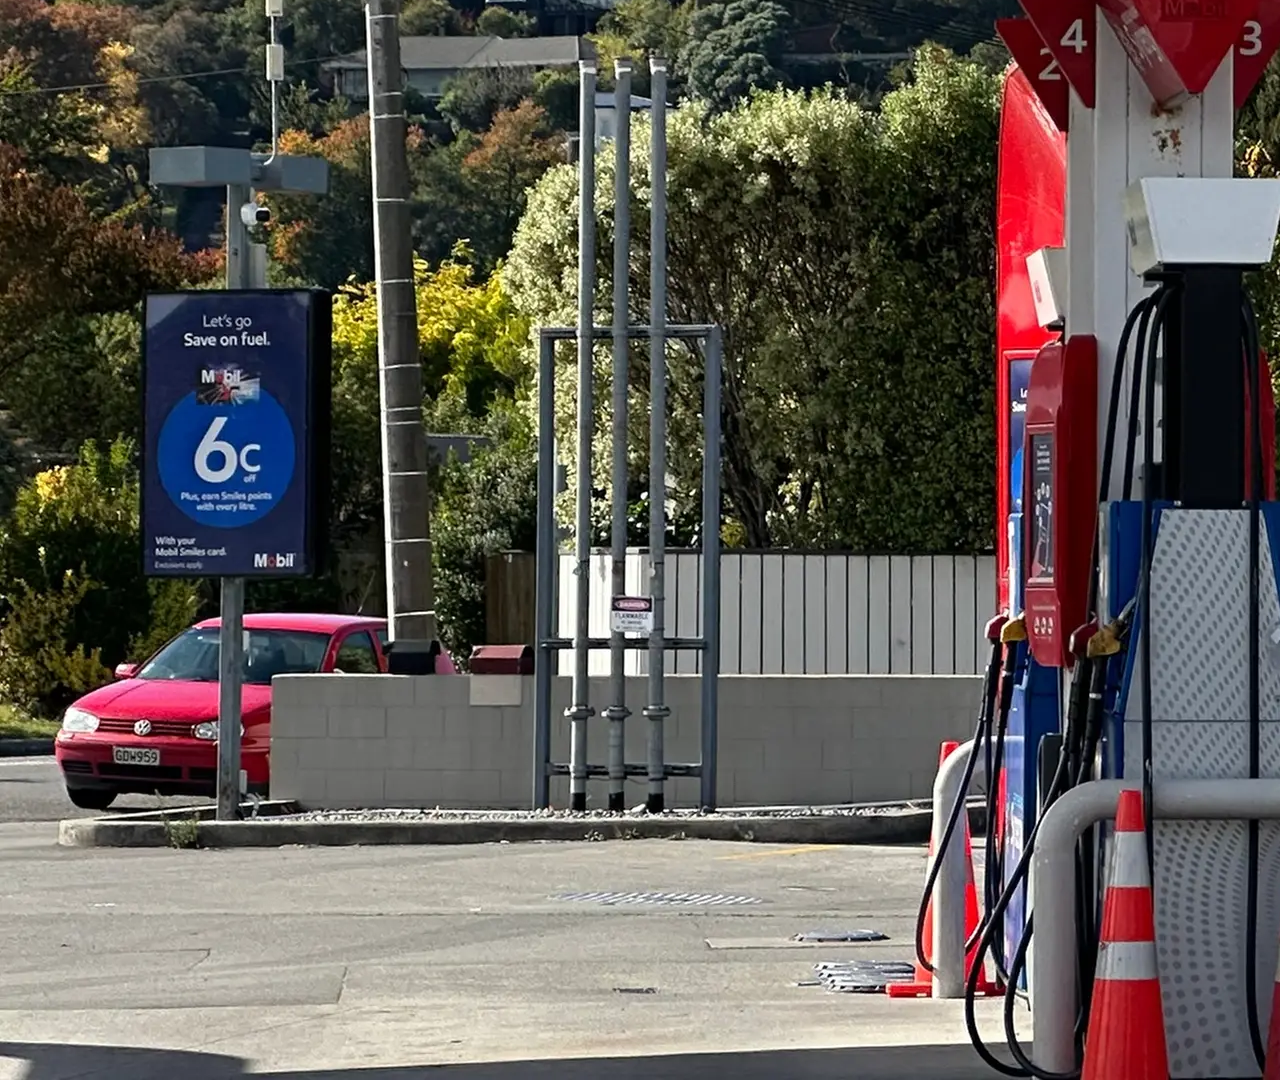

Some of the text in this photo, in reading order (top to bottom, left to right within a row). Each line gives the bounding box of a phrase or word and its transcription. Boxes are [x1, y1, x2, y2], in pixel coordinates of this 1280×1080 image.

[1060, 19, 1087, 53] 4
[1240, 20, 1262, 56] 3
[1038, 47, 1062, 80] 2
[203, 314, 252, 330] Let's go
[184, 331, 271, 346] Save on fuel.
[194, 416, 261, 483] 6c
[243, 474, 256, 483] off
[181, 492, 200, 501] Plus,
[221, 491, 247, 501] Smiles
[247, 491, 272, 502] points
[196, 502, 214, 511] with
[216, 504, 237, 513] every
[155, 537, 196, 547] With your
[155, 548, 178, 556] Mobil
[179, 548, 206, 556] Smiles
[254, 553, 294, 568] Mobil
